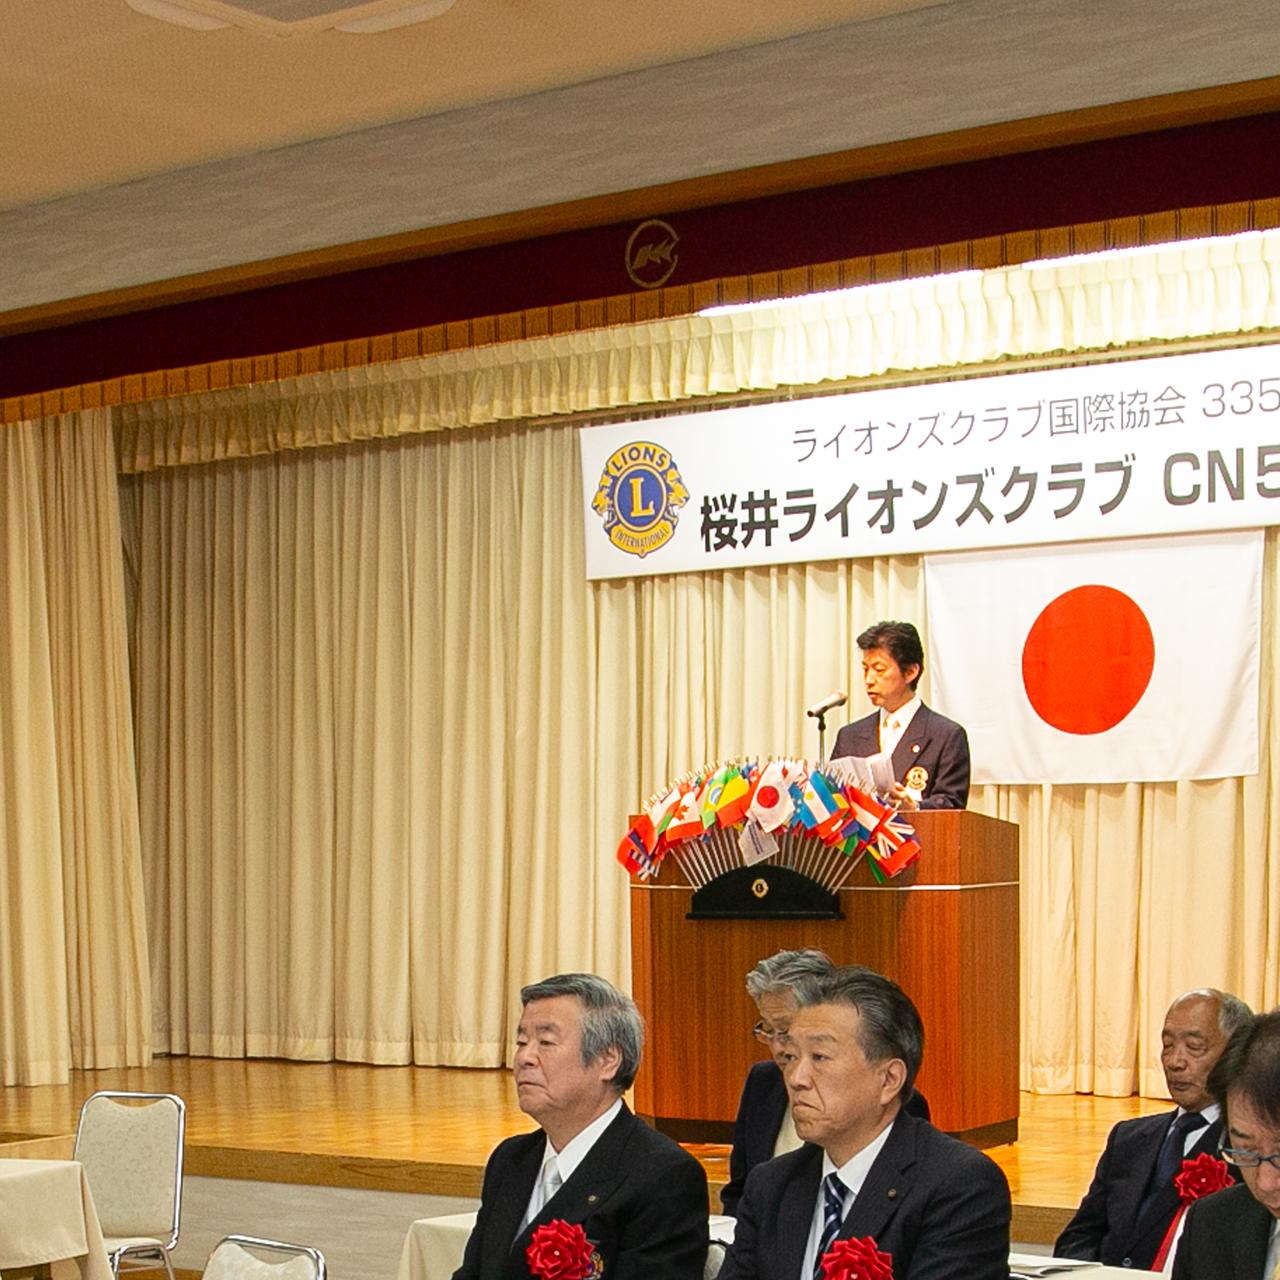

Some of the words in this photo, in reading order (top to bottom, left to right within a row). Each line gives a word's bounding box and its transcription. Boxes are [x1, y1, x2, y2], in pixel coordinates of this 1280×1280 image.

[793, 385, 1187, 463] ライオンズクラブ国際協会
[612, 446, 667, 472] LIONS
[629, 477, 655, 517] L
[700, 452, 1137, 553] 桜井ライオンズクラブ
